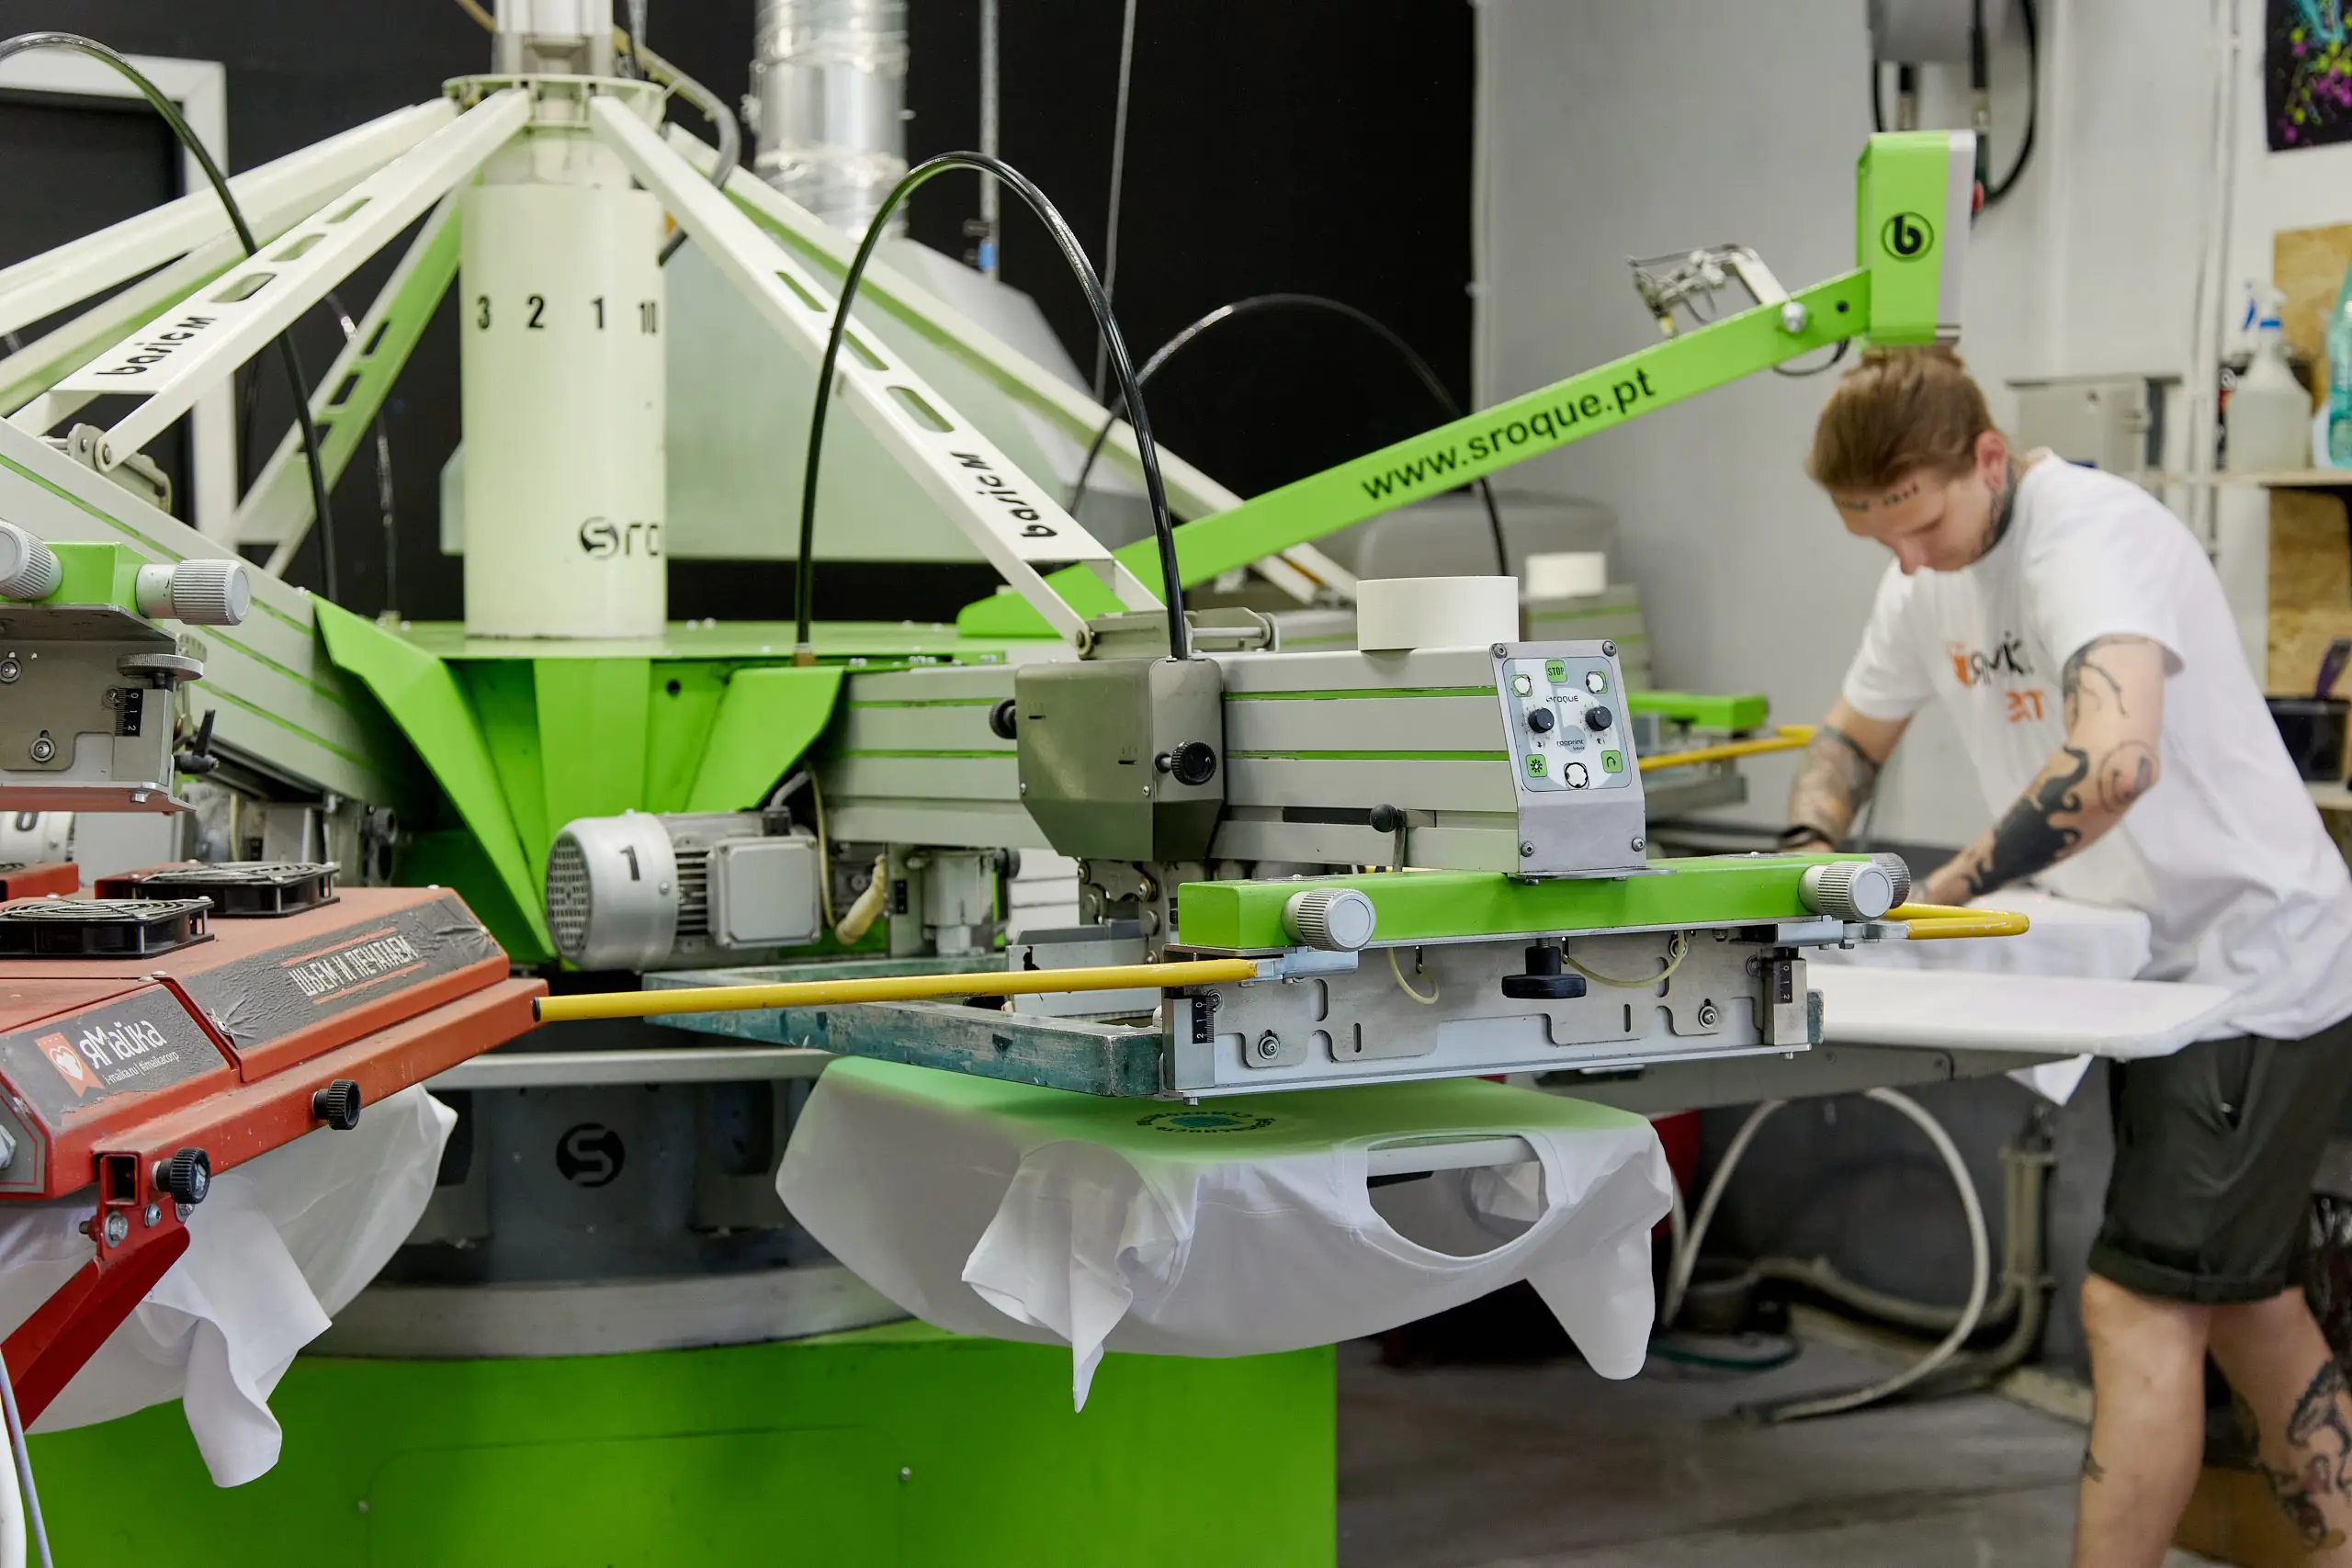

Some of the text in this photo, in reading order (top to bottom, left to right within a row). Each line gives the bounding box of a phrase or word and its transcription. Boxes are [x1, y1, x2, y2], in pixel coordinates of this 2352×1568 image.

[477, 295, 492, 330] 3
[526, 294, 546, 329] 2
[593, 297, 604, 329] 1
[1360, 367, 1657, 500] www.sroque.pt
[1547, 666, 1565, 676] STOP
[620, 845, 640, 881] 1
[331, 954, 357, 982] И
[344, 934, 419, 978] ПЕЧАТАЕМ
